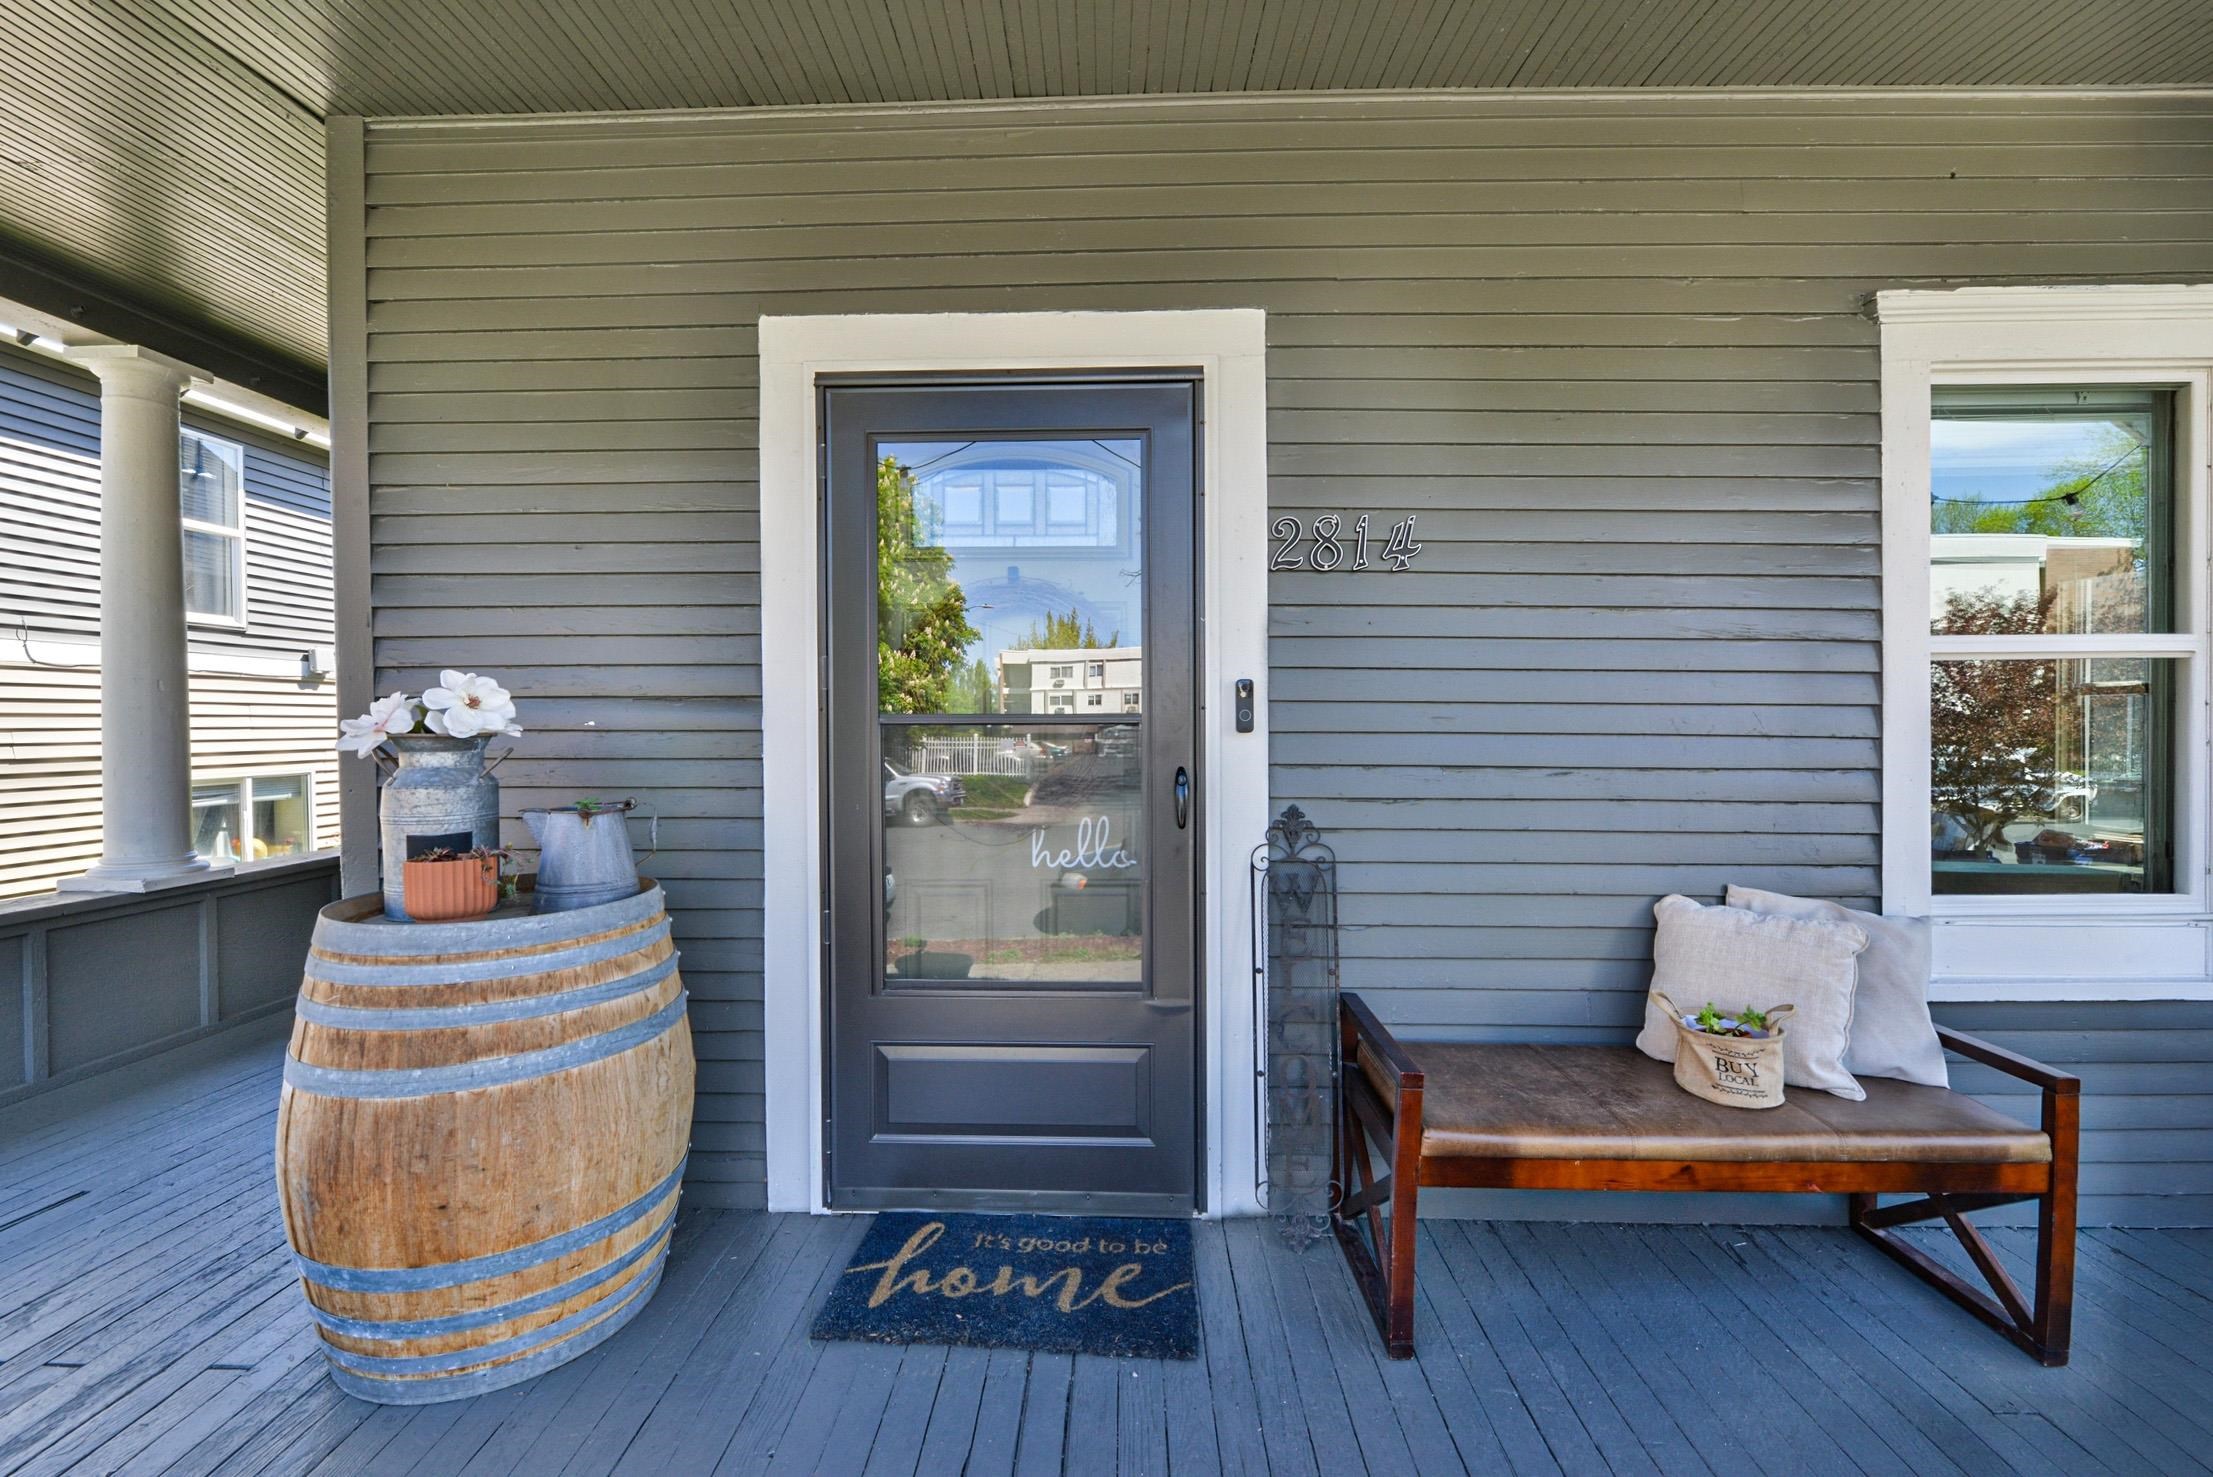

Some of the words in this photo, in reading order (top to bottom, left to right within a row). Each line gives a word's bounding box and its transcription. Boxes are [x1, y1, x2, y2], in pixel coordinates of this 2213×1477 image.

[1271, 514, 1422, 572] 2814
[1031, 815, 1137, 868] hello
[1715, 1057, 1759, 1078] BUY
[1718, 1072, 1759, 1087] LOCAL
[974, 1231, 1010, 1251] It's
[1018, 1236, 1090, 1254] good
[1099, 1237, 1126, 1254] to
[1133, 1239, 1169, 1256] be
[844, 1221, 1193, 1314] home
